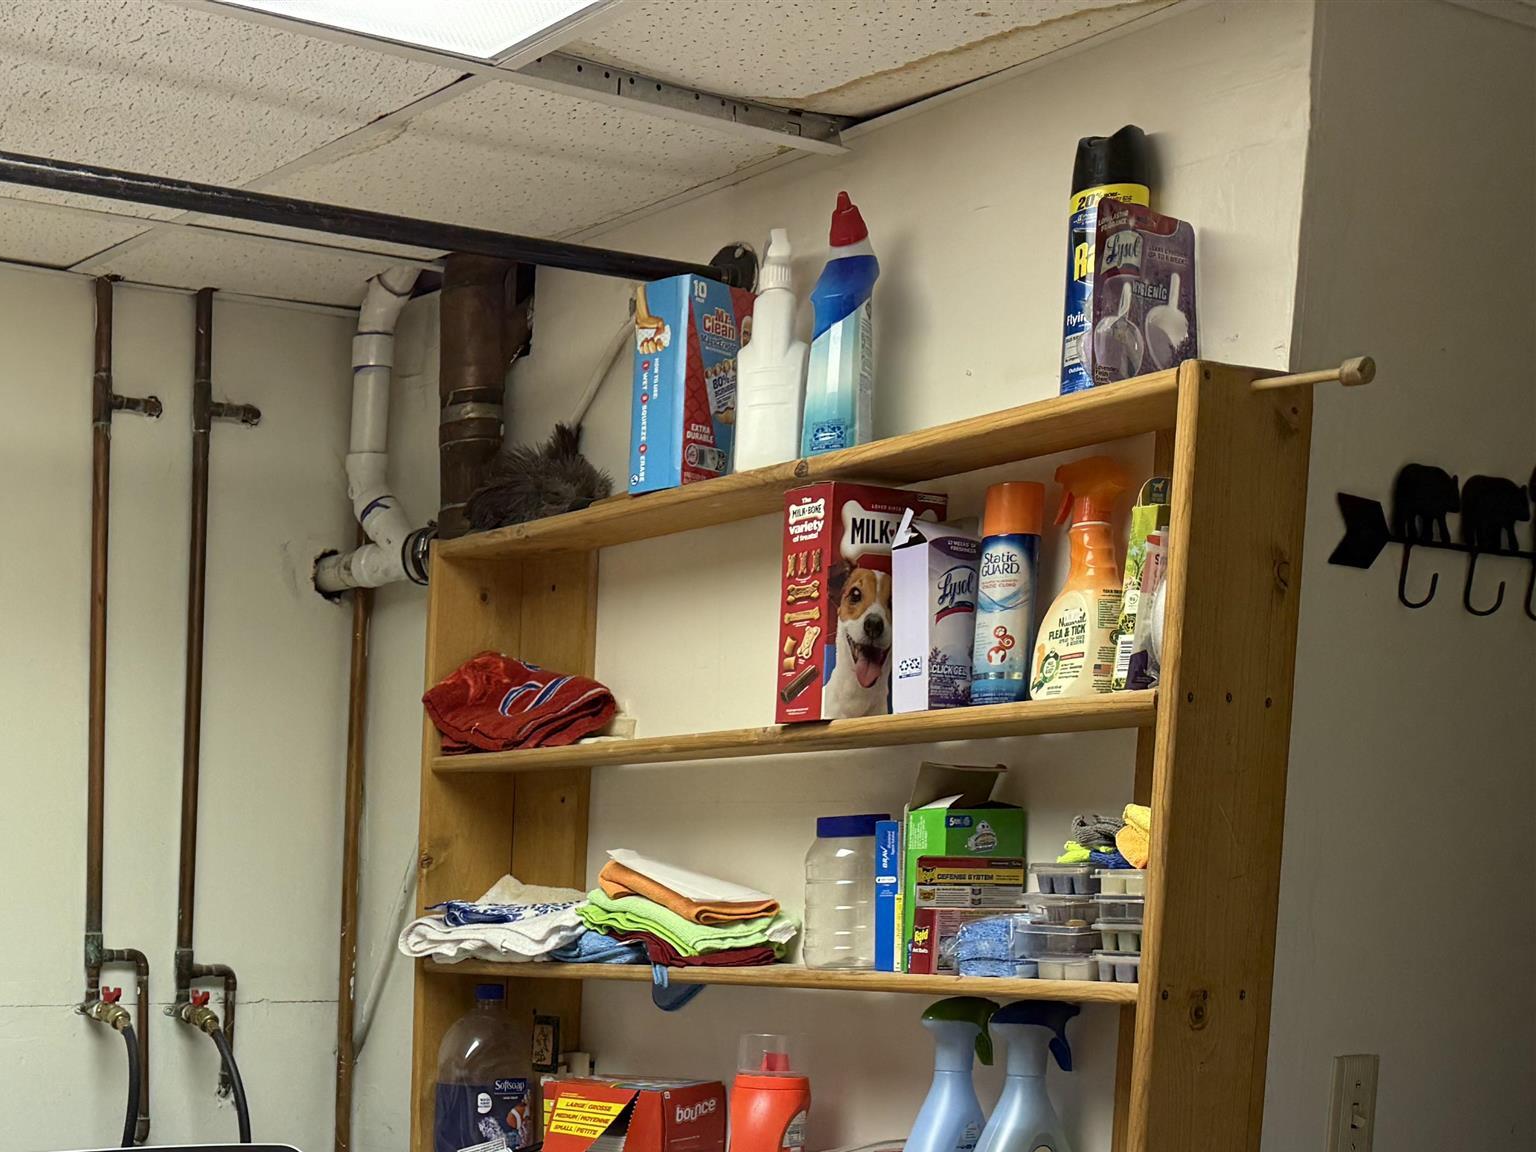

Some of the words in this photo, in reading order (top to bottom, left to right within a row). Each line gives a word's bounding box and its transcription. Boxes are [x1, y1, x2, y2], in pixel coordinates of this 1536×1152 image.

[1105, 234, 1140, 265] Lysol
[693, 279, 707, 298] 10
[714, 306, 732, 325] Mr.
[702, 313, 736, 341] Clean
[789, 519, 825, 535] variety
[984, 551, 1018, 565] Static
[981, 562, 1020, 577] GUARD
[937, 572, 976, 606] Lysol
[1071, 623, 1086, 636] TICK
[494, 1079, 526, 1093] Softsoap
[565, 1101, 586, 1109] LARGE
[587, 1103, 613, 1112] GROSSE
[675, 1098, 716, 1124] bounce
[554, 1112, 579, 1121] MEDIUM
[553, 1124, 574, 1133] SMALL
[575, 1126, 599, 1136] PETITE
